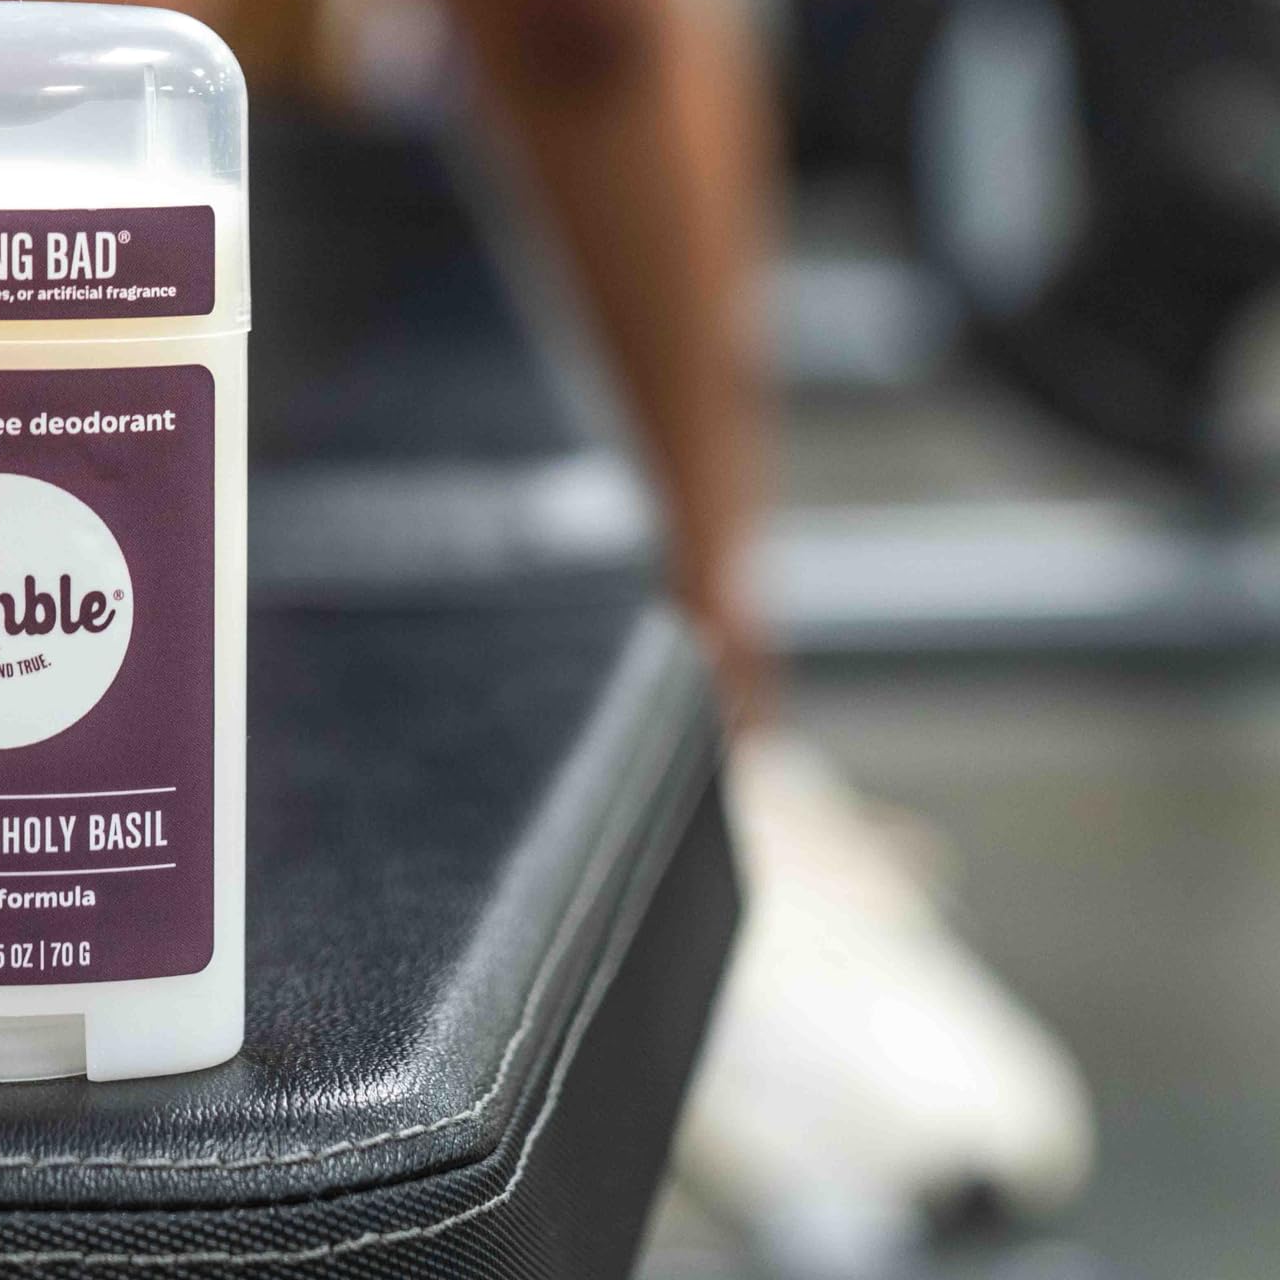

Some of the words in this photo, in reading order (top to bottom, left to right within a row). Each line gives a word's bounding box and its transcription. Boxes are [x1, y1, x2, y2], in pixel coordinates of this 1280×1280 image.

[17, 290, 35, 301] or
[37, 284, 102, 301] artificial
[106, 284, 177, 302] fragrance
[29, 409, 176, 436] deodorant
[17, 653, 52, 676] TRUE.
[2, 815, 77, 854] HOLY
[89, 810, 168, 852] BASIL
[10, 943, 34, 968] OZ
[51, 942, 74, 967] 70
[79, 941, 91, 967] G
